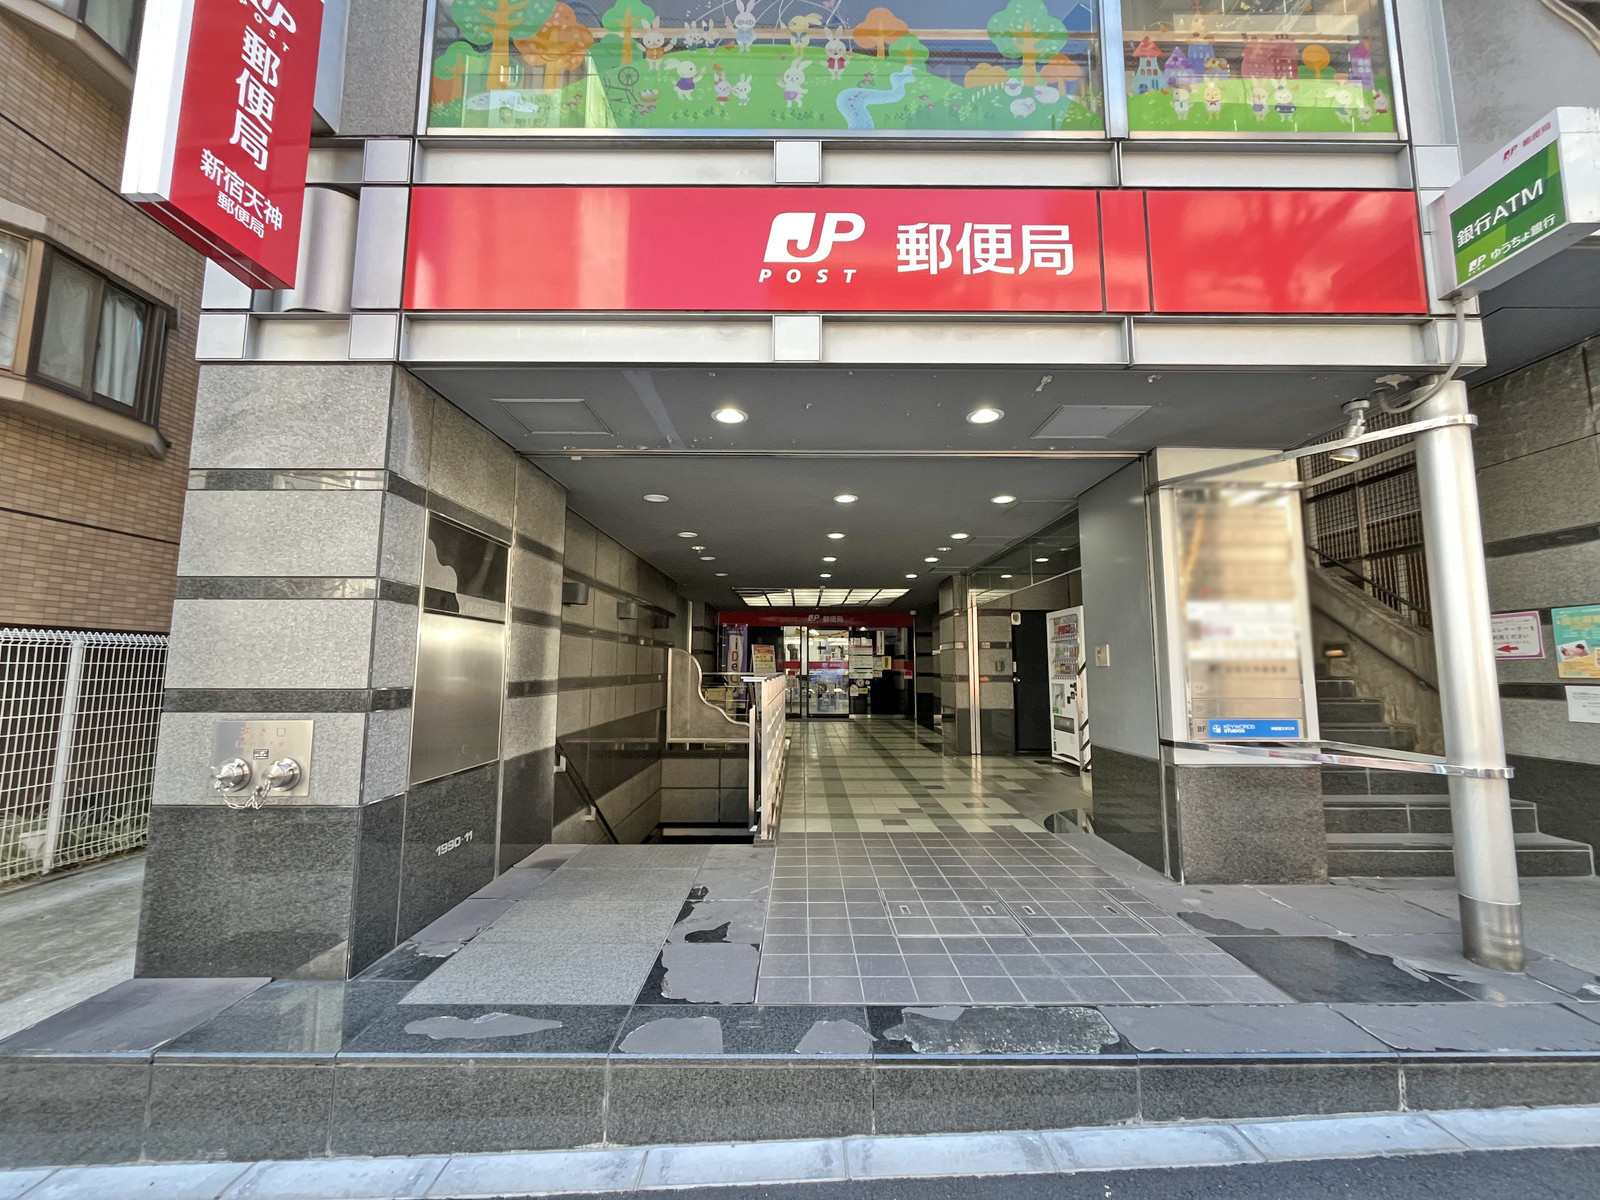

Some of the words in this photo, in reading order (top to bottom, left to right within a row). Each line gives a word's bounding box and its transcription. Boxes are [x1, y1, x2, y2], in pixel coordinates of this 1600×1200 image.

[229, 25, 281, 171] 郵便局
[200, 147, 283, 231] 新宿天神
[217, 190, 265, 239] 郵便局
[1456, 178, 1544, 248] 銀行ATM
[763, 212, 866, 263] JP
[896, 222, 1074, 275] 郵便局
[1490, 213, 1556, 260] ゆうちょ銀行
[758, 268, 857, 283] POST
[1197, 725, 1207, 733] BF
